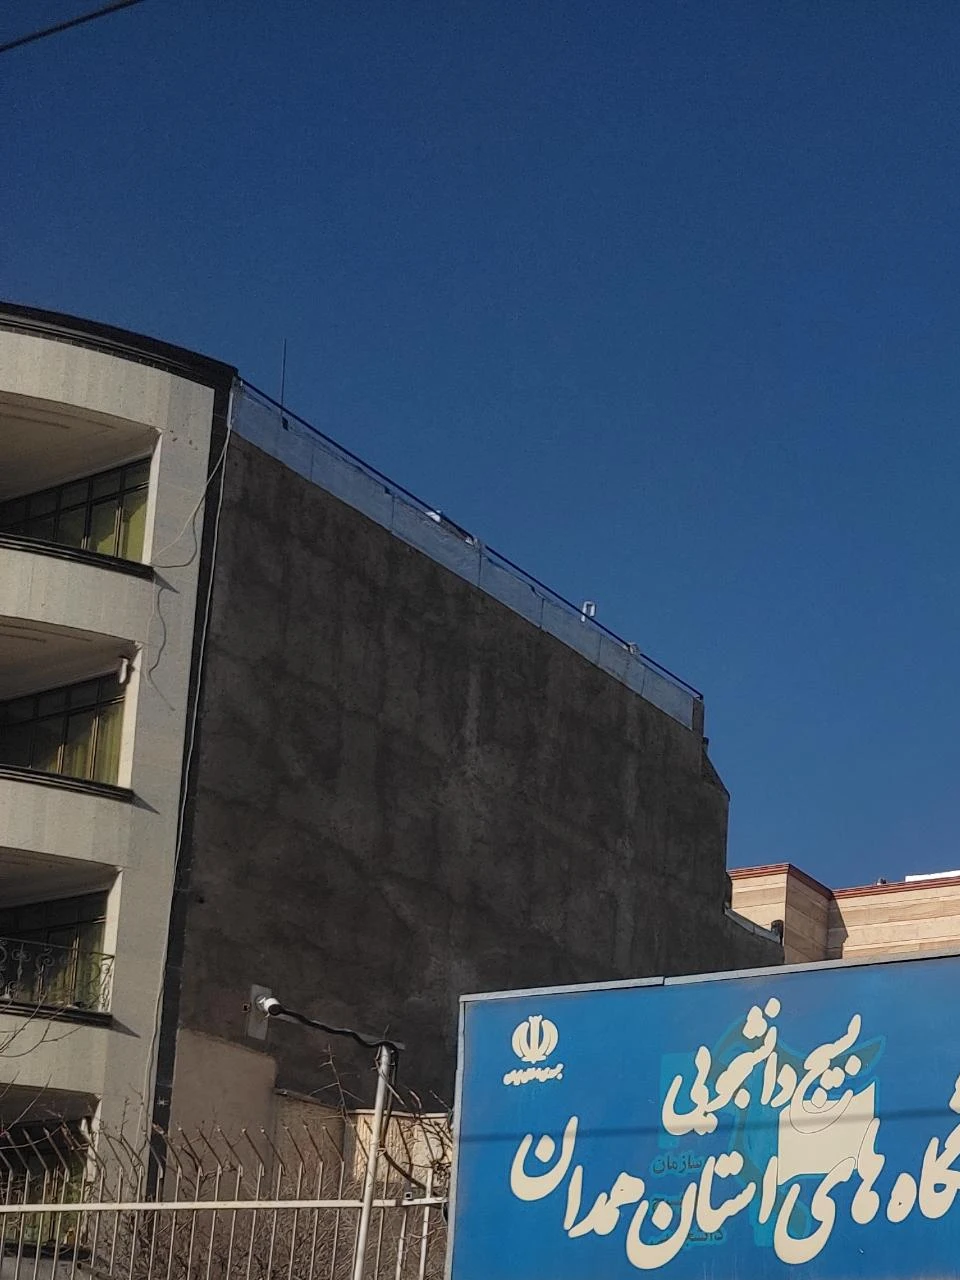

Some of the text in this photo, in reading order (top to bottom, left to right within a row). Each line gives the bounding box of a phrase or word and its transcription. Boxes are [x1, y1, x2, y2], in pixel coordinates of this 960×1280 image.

[661, 997, 862, 1136] بسیج دانشجویی
[509, 1115, 646, 1239] همدان
[625, 1150, 779, 1270] استان
